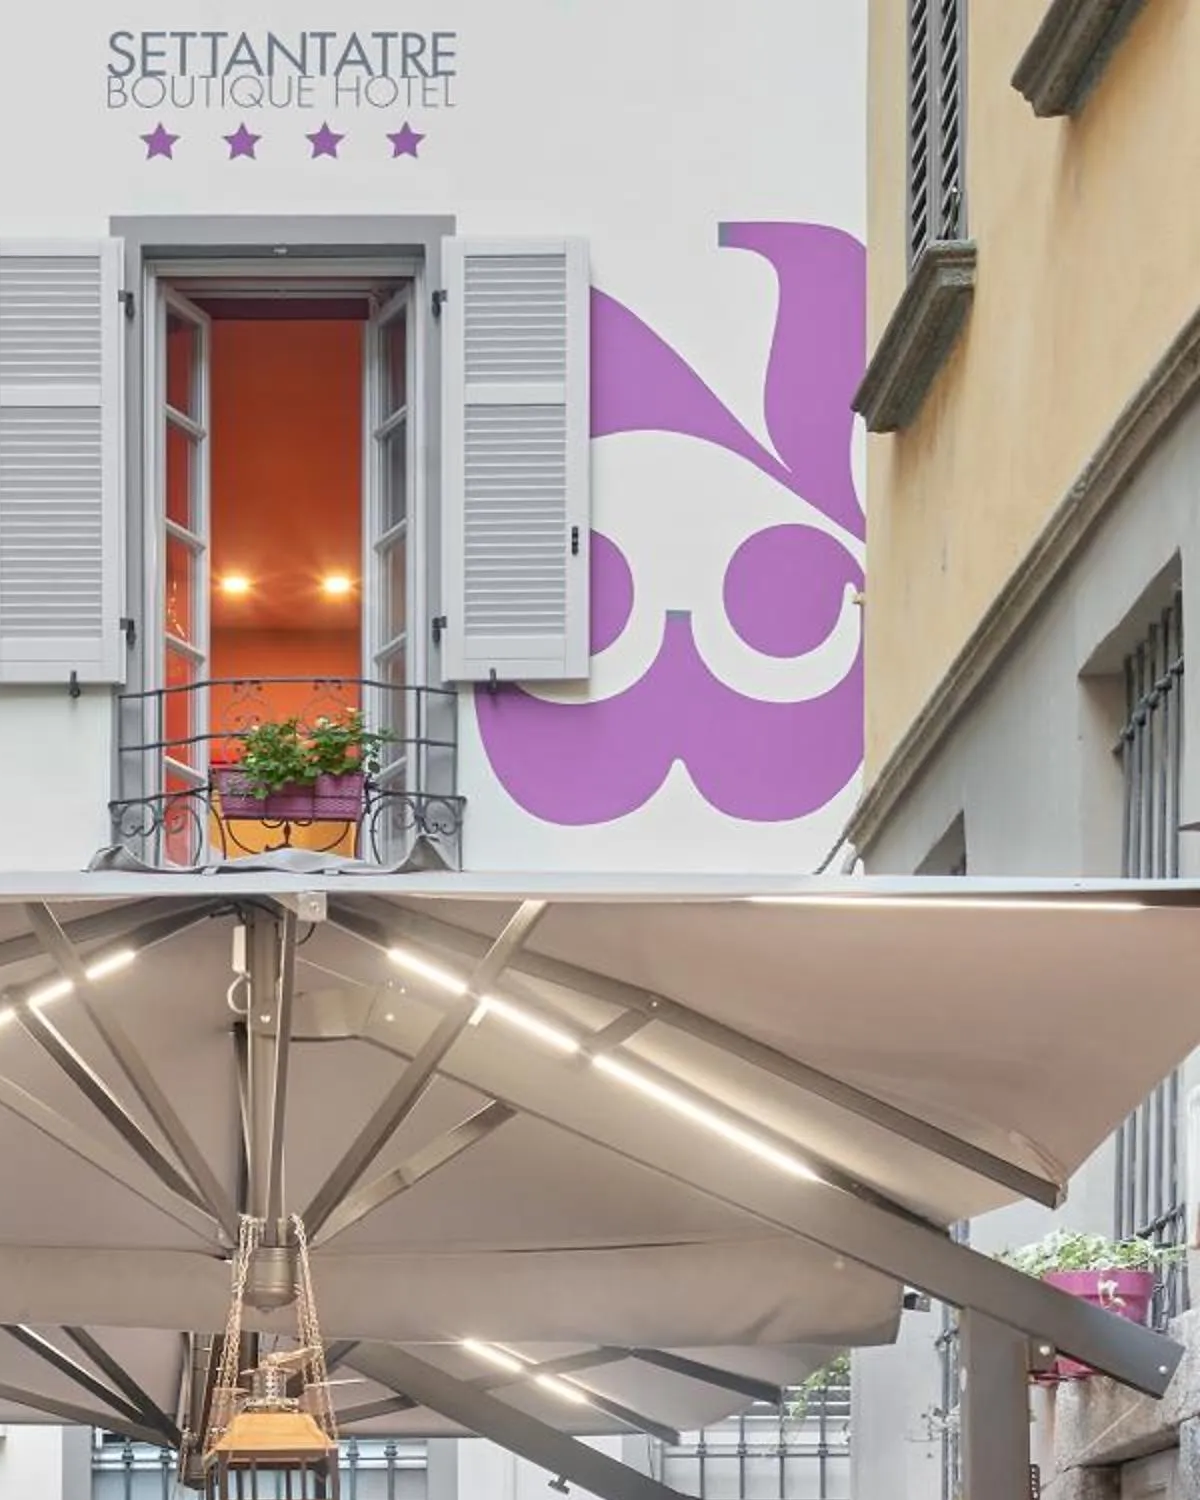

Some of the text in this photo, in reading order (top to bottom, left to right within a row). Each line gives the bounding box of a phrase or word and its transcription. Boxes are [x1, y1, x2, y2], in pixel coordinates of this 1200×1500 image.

[107, 31, 456, 77] SETTANTATRE
[106, 75, 456, 108] BOUTIQUE HOTEL
